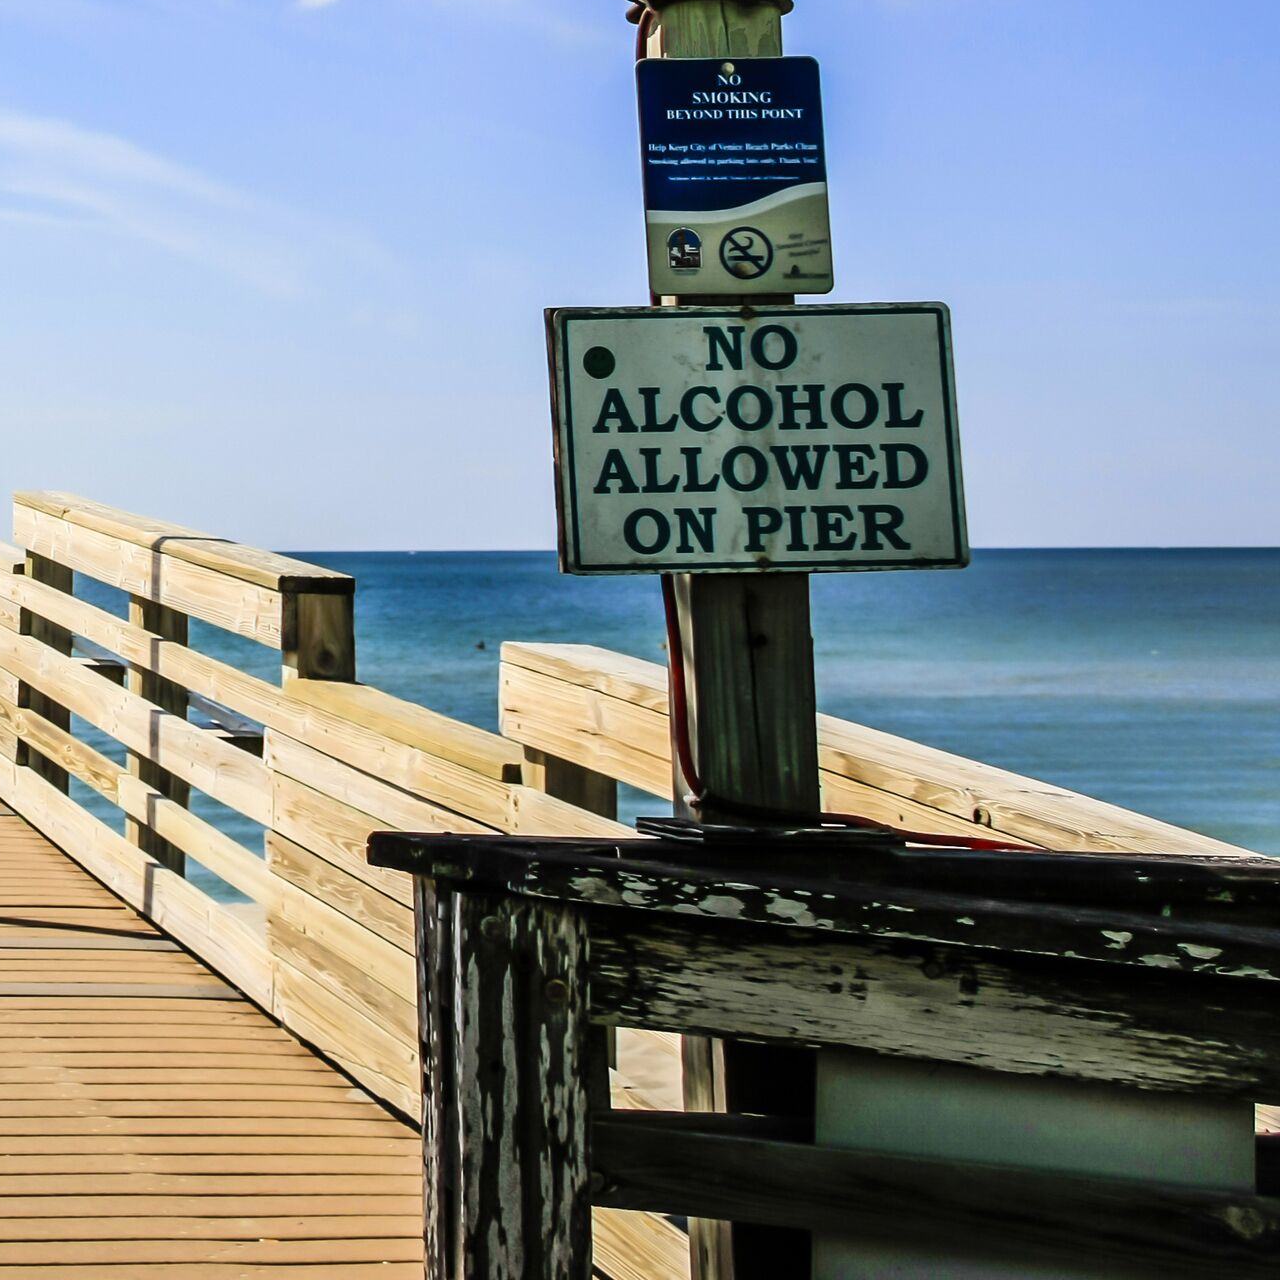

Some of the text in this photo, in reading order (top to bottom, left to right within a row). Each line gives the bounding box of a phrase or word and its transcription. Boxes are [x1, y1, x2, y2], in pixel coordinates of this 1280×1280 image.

[717, 74, 741, 86] NO
[692, 91, 772, 104] SMOKING
[666, 108, 804, 120] BEYOND THIS POINT
[648, 143, 667, 152] Help
[668, 143, 688, 152] Keep
[689, 143, 706, 152] City
[745, 142, 769, 151] Beach
[771, 142, 793, 150] Parks
[795, 142, 818, 150] Clean
[703, 324, 798, 371] NO
[592, 382, 925, 433] ALCOHOL
[593, 443, 929, 494] ALLOWED
[623, 504, 911, 555] ON PIER
